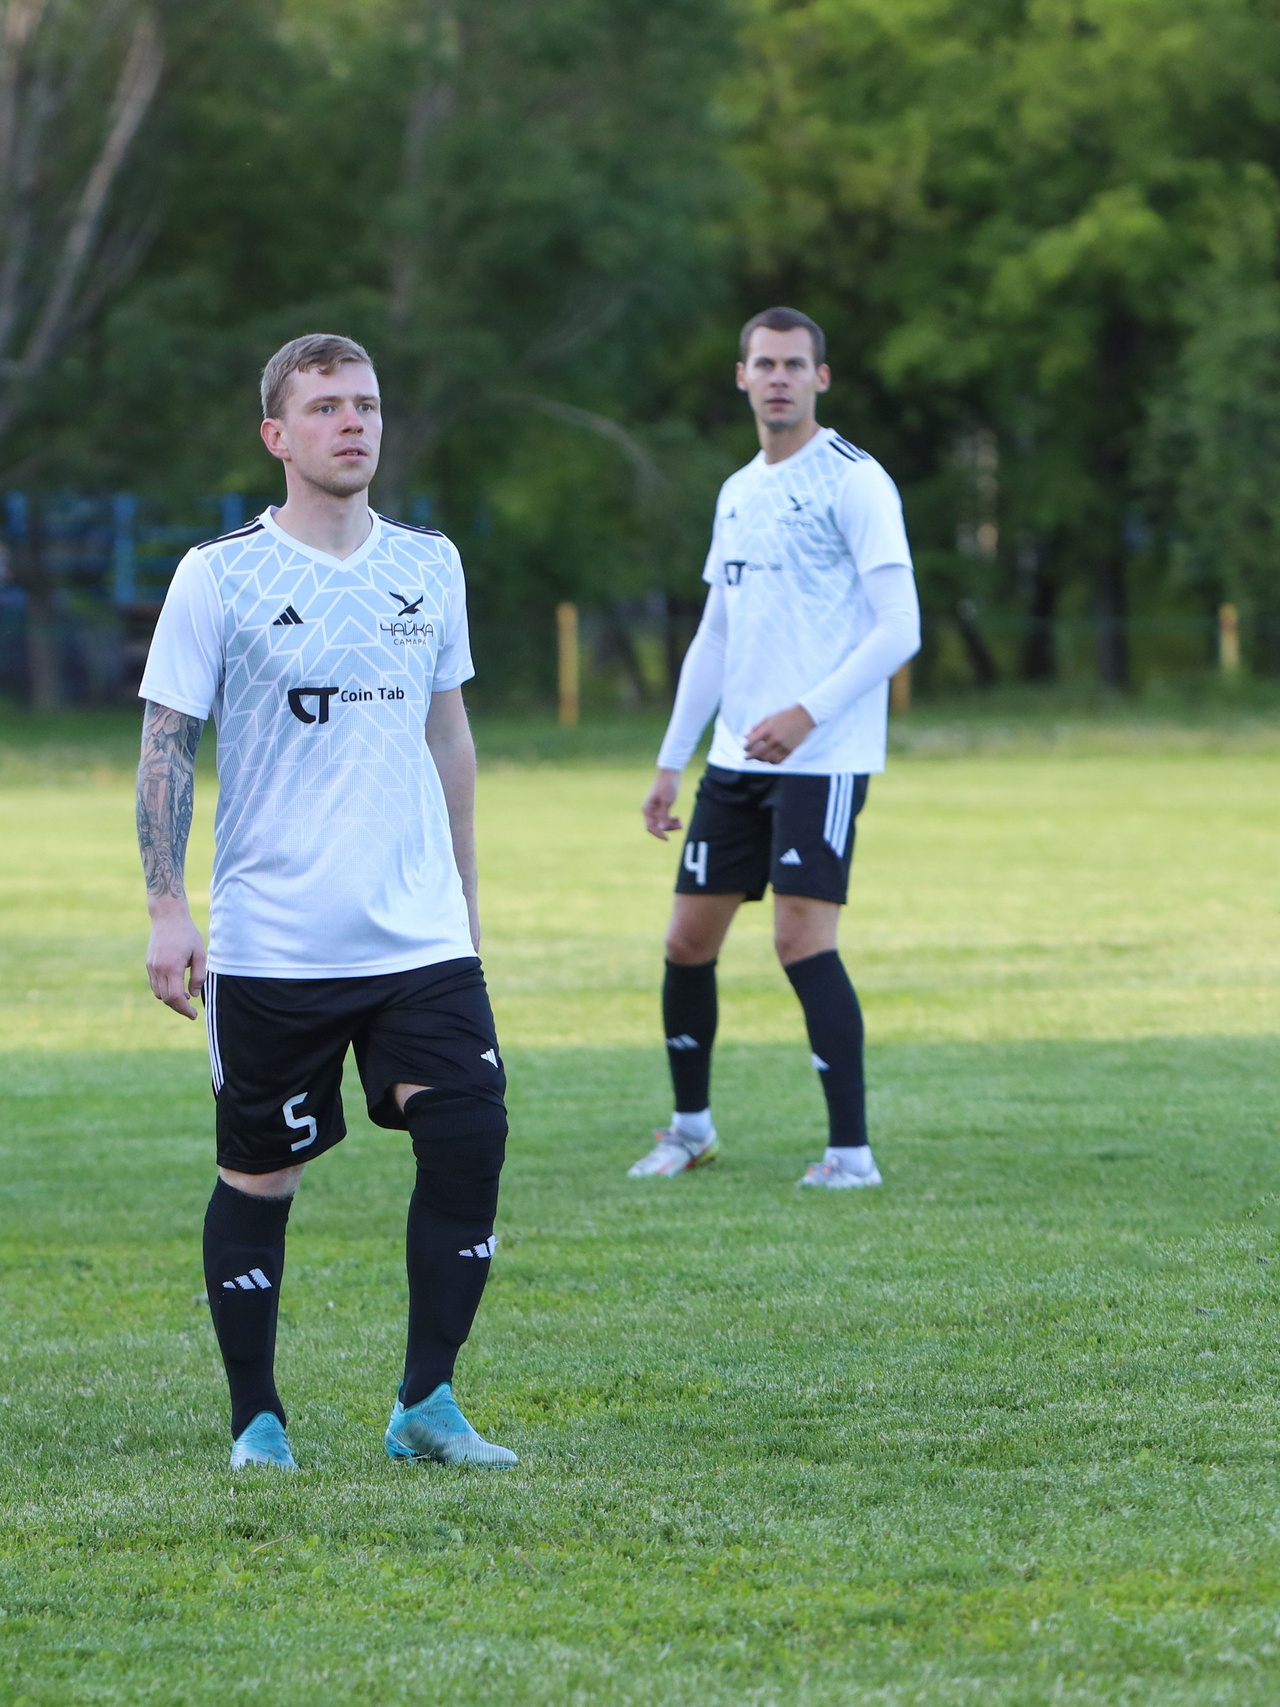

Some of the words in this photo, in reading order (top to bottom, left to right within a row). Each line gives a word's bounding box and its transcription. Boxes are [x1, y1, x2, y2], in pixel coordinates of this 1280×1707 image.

[380, 619, 433, 637] ЧАЙКА
[393, 638, 427, 646] САМАРА
[341, 688, 373, 703] Coin
[377, 686, 405, 700] Tab
[684, 840, 708, 886] 4
[282, 1091, 318, 1152] 5
